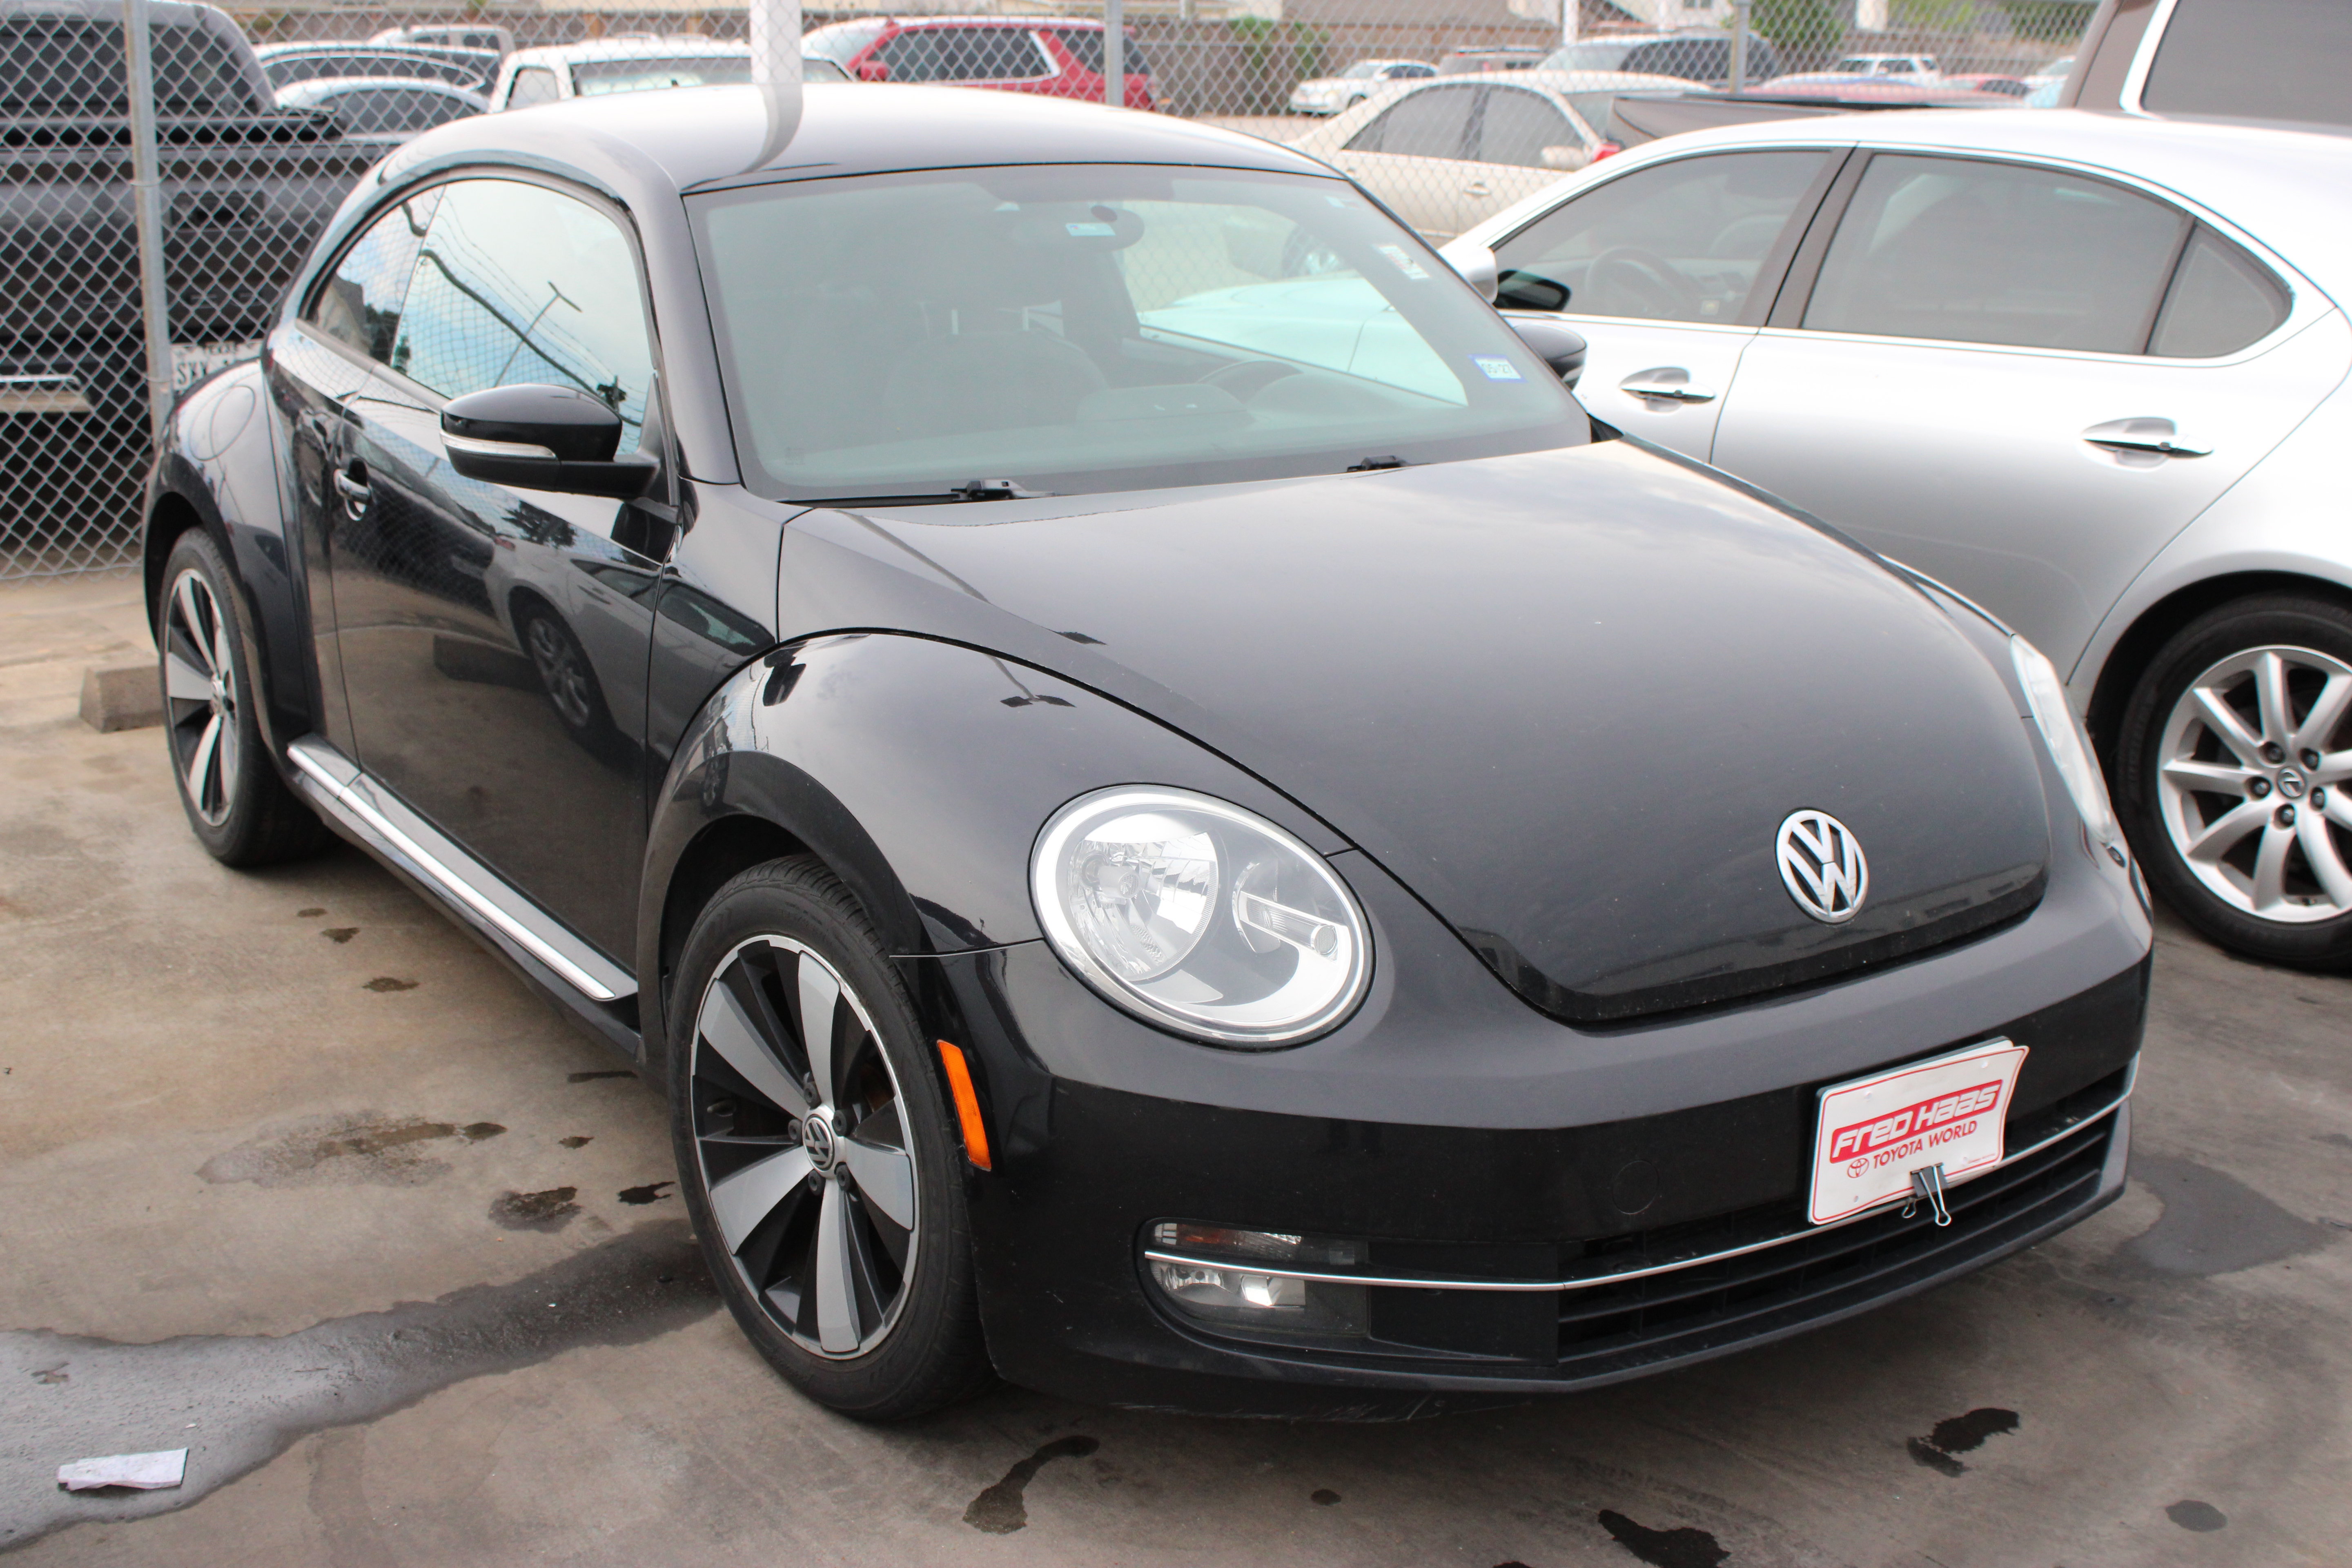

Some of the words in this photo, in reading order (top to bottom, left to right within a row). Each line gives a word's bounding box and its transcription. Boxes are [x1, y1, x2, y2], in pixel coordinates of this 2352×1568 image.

[1914, 1084, 2001, 1132] Haas
[1873, 1138, 1923, 1169] TOYOTA
[1928, 1120, 1978, 1148] WORLD
